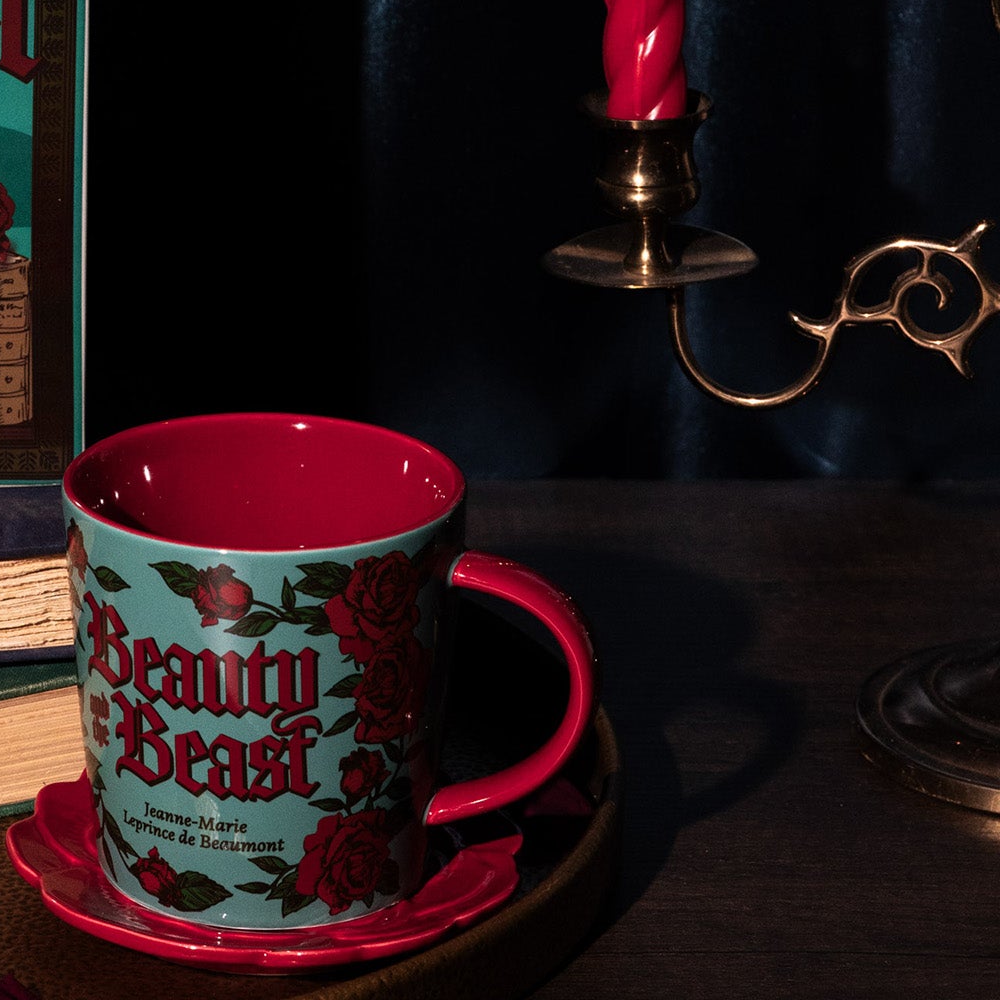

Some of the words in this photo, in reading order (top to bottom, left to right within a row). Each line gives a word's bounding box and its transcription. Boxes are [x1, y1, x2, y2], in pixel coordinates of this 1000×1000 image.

[83, 590, 323, 737] Beauty
[110, 690, 323, 802] Beast
[122, 810, 176, 842] Leprince
[178, 831, 196, 847] de
[199, 833, 285, 852] Beaumont
[144, 801, 248, 835] Jeanne-Marie
